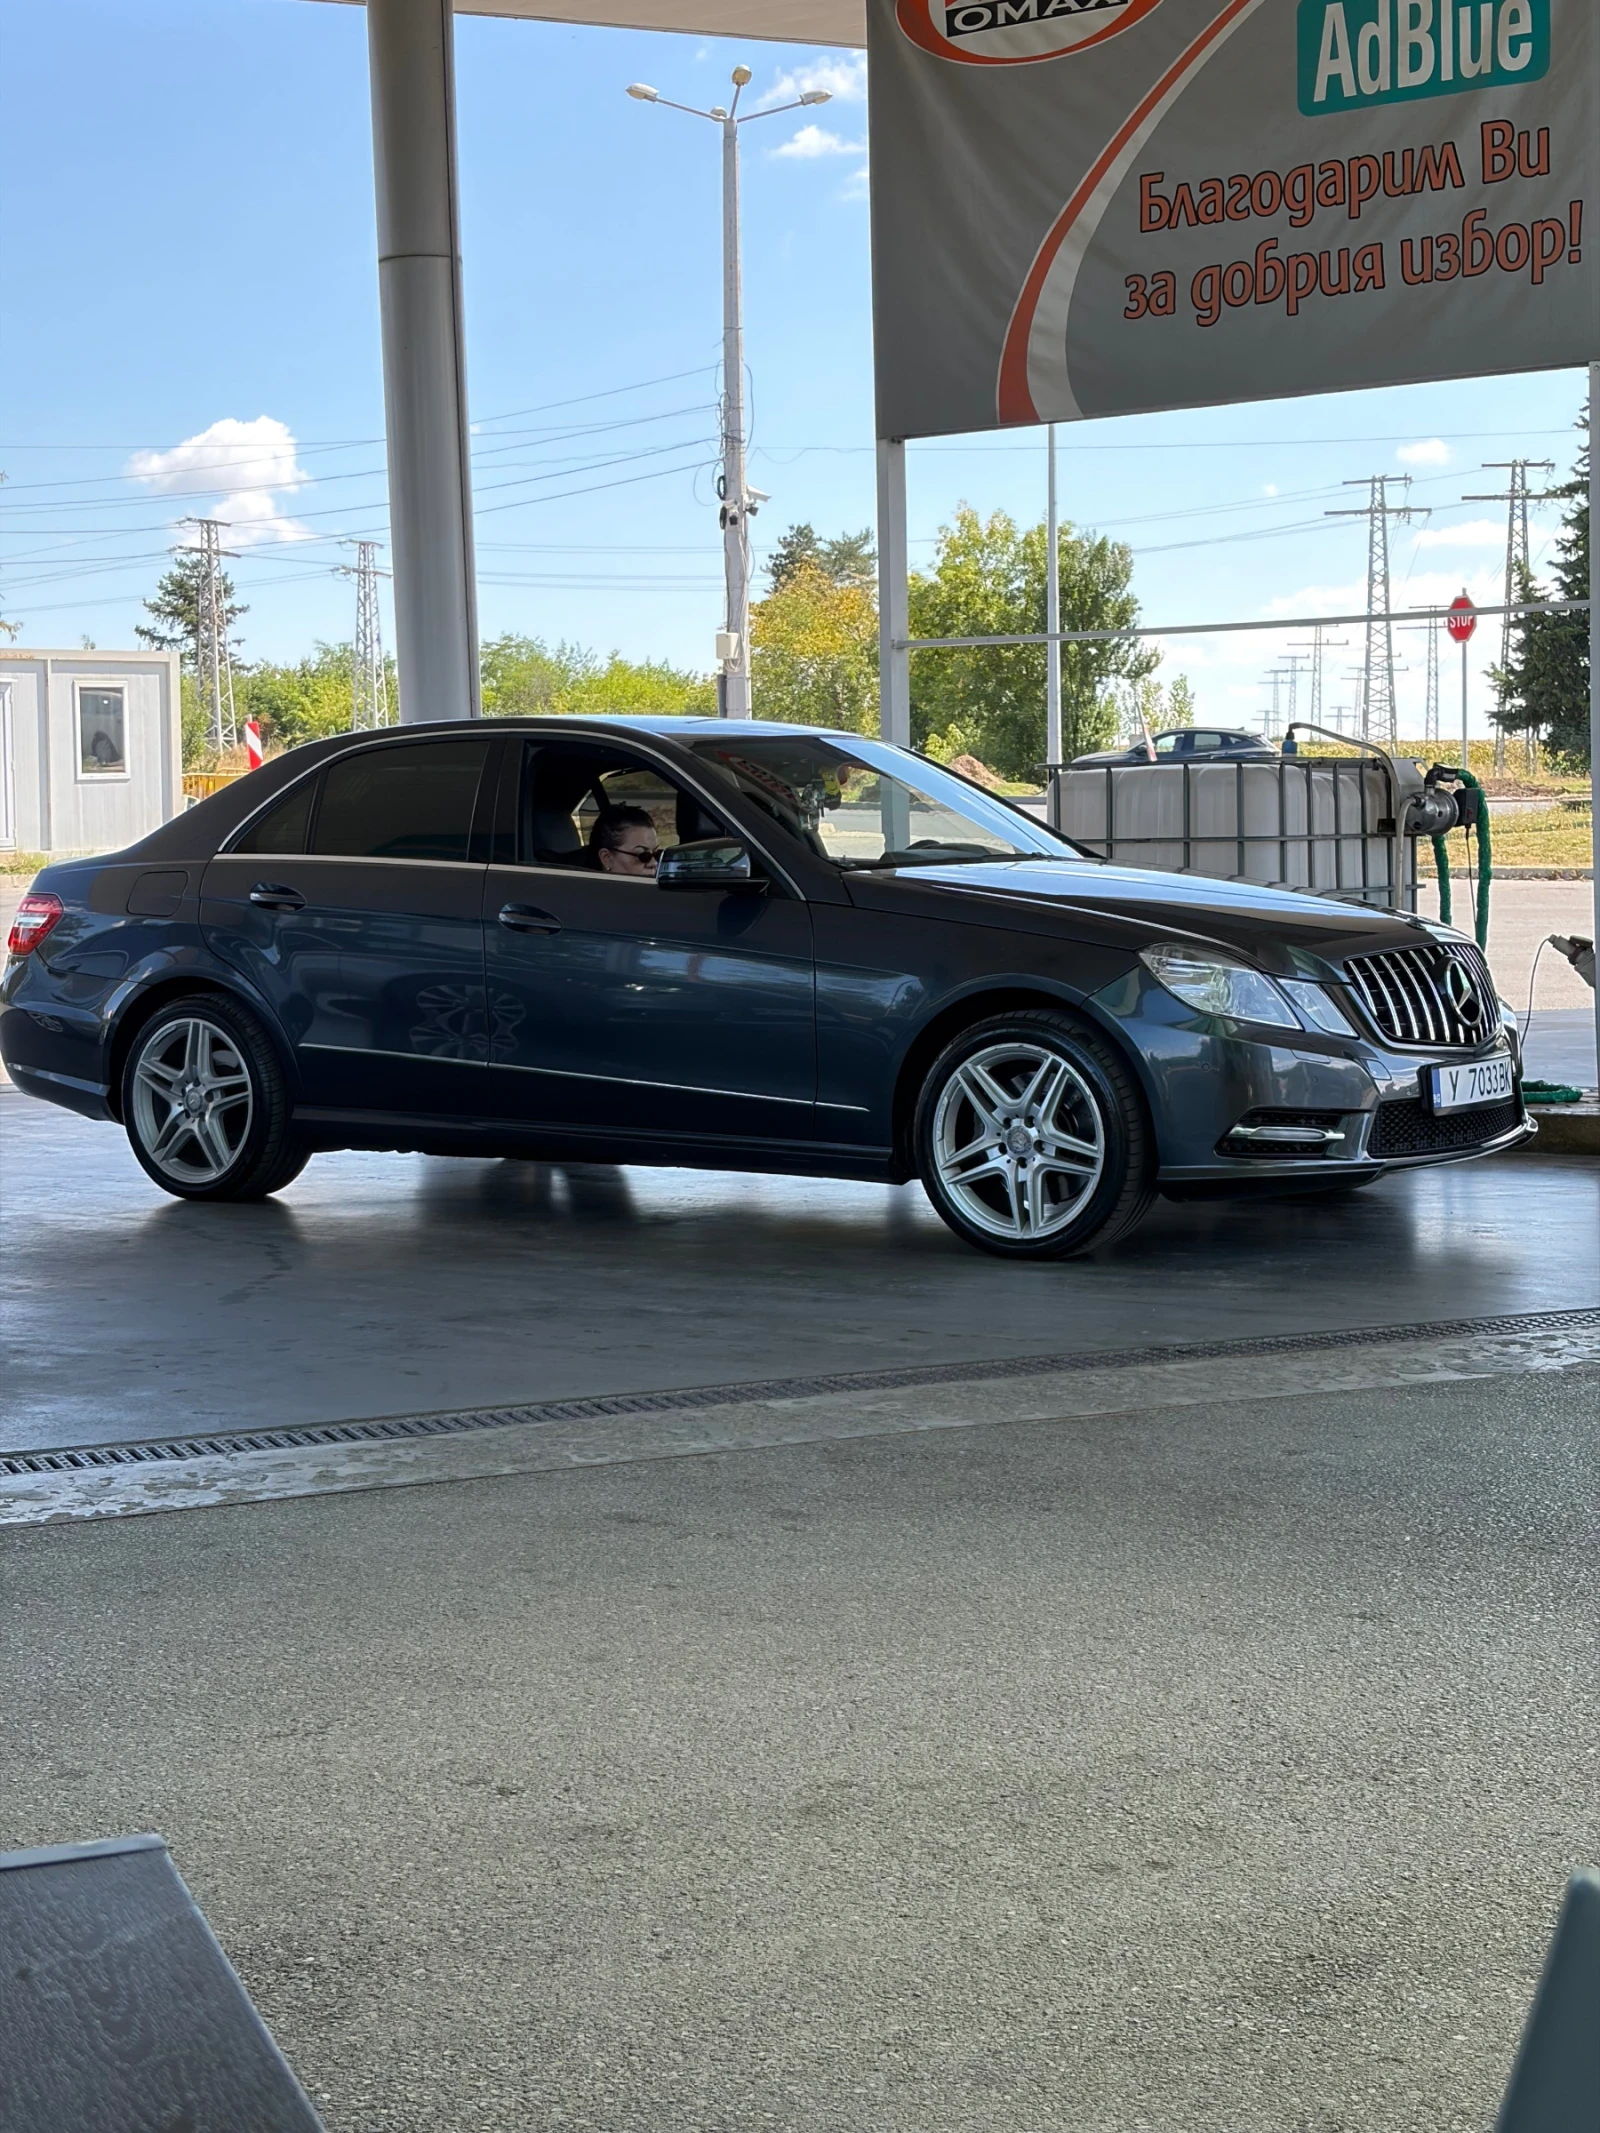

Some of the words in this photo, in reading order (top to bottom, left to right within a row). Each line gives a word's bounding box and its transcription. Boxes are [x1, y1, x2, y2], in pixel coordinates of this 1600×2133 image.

[953, 0, 1122, 32] OMA
[1313, 0, 1533, 102] AdBlue
[1139, 141, 1465, 233] Благодарим
[1481, 119, 1550, 184] Ви
[1123, 270, 1176, 320] за
[1191, 238, 1386, 328] добрия
[1400, 200, 1584, 285] избор!
[1449, 614, 1474, 628] STOP
